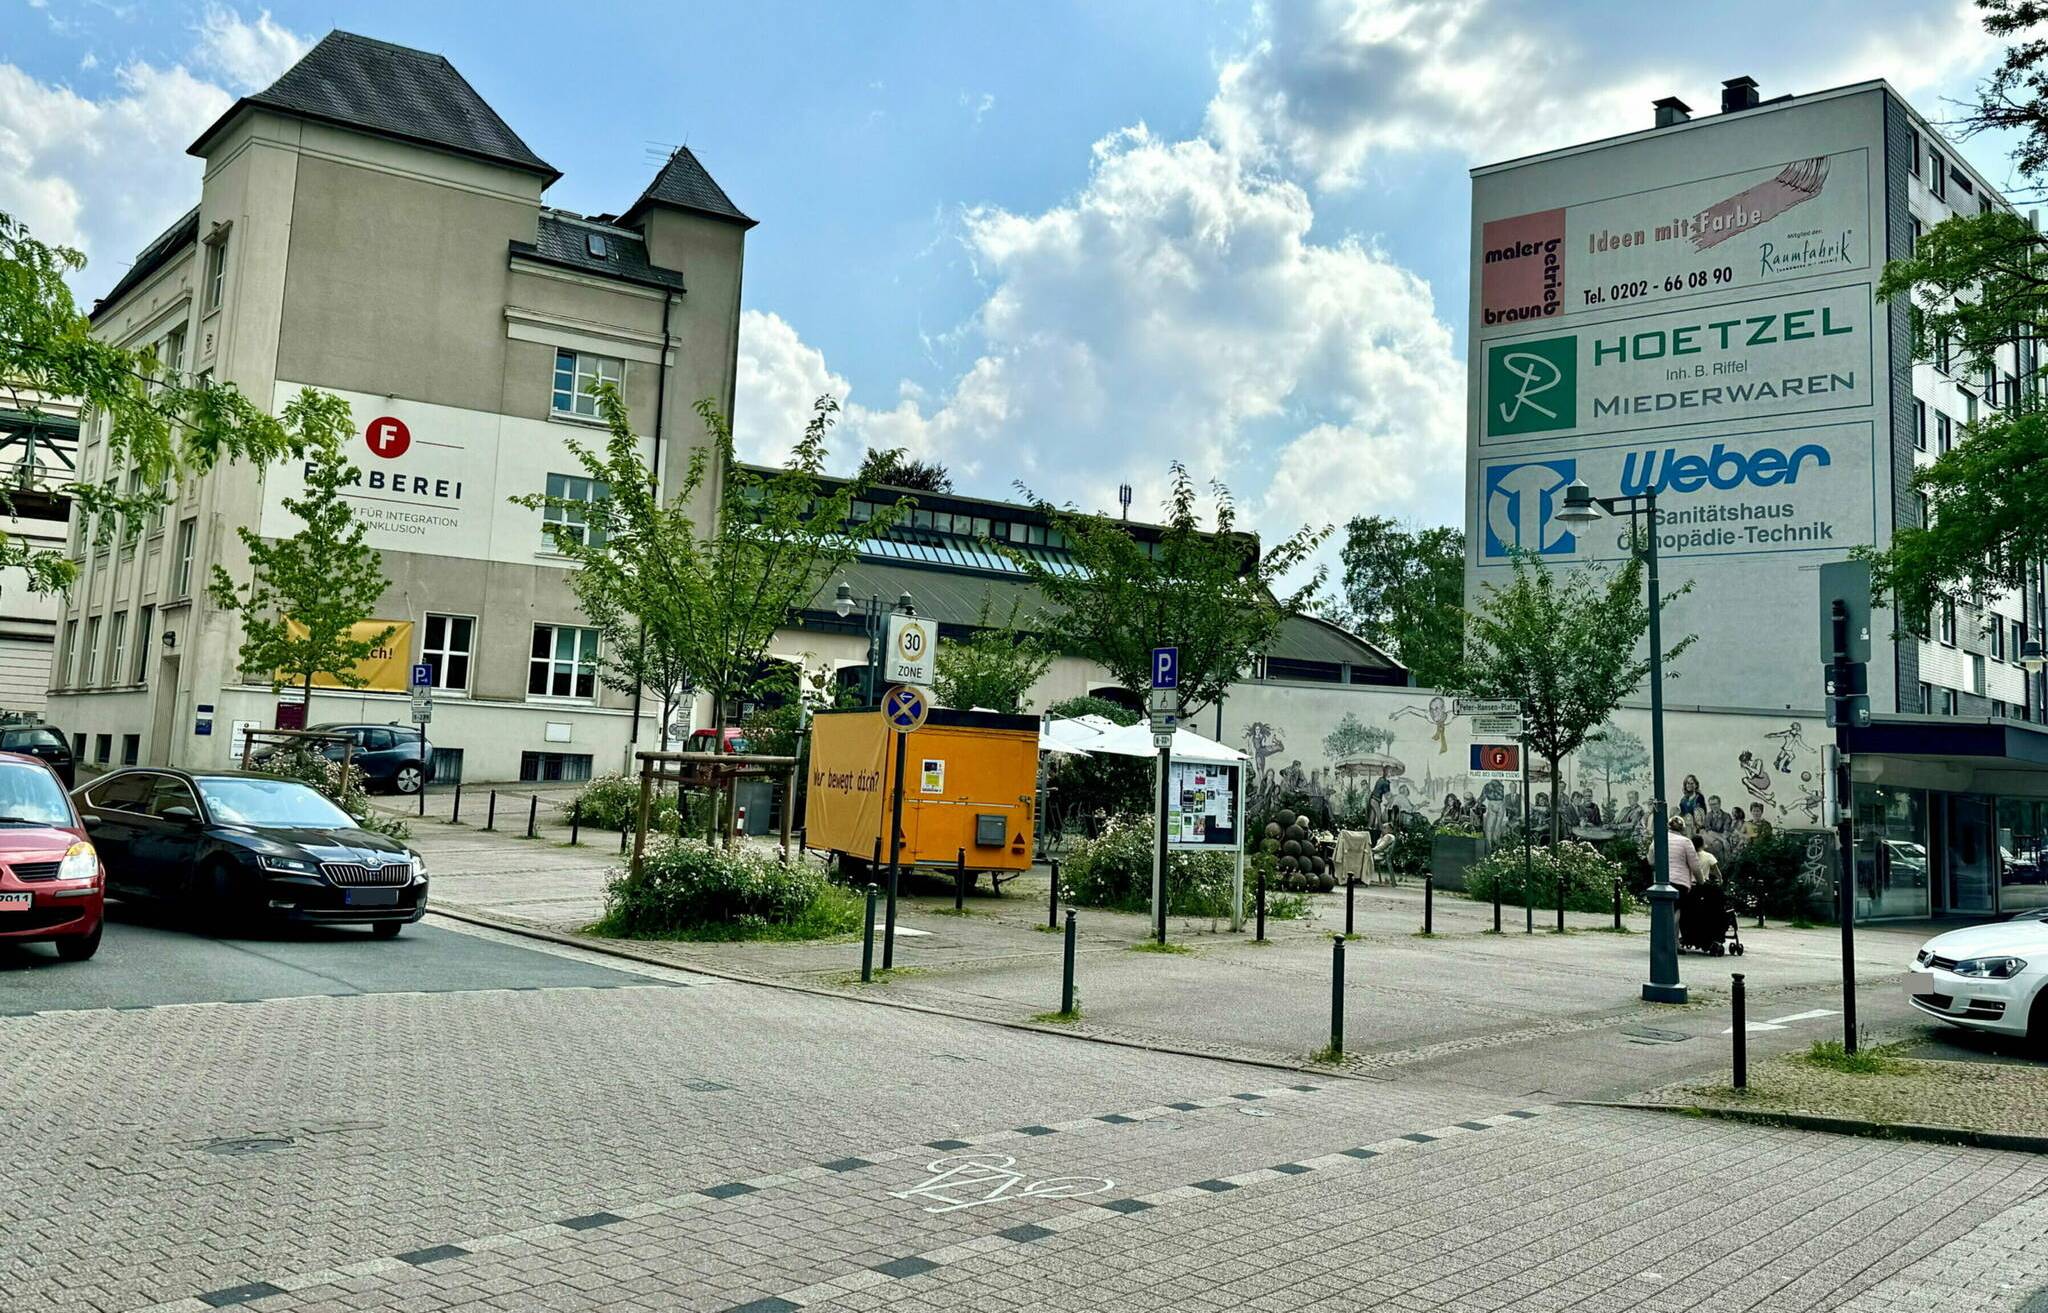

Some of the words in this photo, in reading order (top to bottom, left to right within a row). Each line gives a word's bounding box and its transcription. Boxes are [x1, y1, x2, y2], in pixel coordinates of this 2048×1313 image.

[1589, 229, 1645, 254] Ideen
[1655, 218, 1689, 242] mit
[1700, 203, 1763, 234] Farbe
[1485, 241, 1543, 264] maler
[1760, 231, 1852, 278] Raumfabrik
[1543, 238, 1561, 316] betrieb
[1584, 287, 1606, 305] Tel.
[1610, 280, 1648, 301] 0202
[1664, 274, 1683, 293] 66
[1688, 270, 1708, 289] 08
[1713, 266, 1733, 284] 90
[1485, 303, 1542, 325] braun
[1594, 307, 1853, 367] HOETZEL
[1666, 367, 1688, 381] Inh.
[1695, 364, 1709, 378] B.
[1713, 360, 1748, 376] Riffel
[378, 424, 398, 450] F
[304, 461, 462, 500] FRBEREI
[1620, 443, 1831, 497] Weber
[360, 506, 383, 518] FÜR
[386, 511, 458, 528] INTEGRATION
[1655, 502, 1794, 526] Sanitätshaus
[366, 520, 426, 535] INKLUSION
[904, 633, 920, 651] 30
[415, 667, 426, 684] P
[898, 665, 923, 679] ZONE
[1158, 653, 1172, 683] P
[1459, 702, 1517, 711] Peter-Hansen-Platz
[1496, 754, 1503, 763] F
[828, 768, 853, 795] bewegt
[857, 768, 880, 793] dich?
